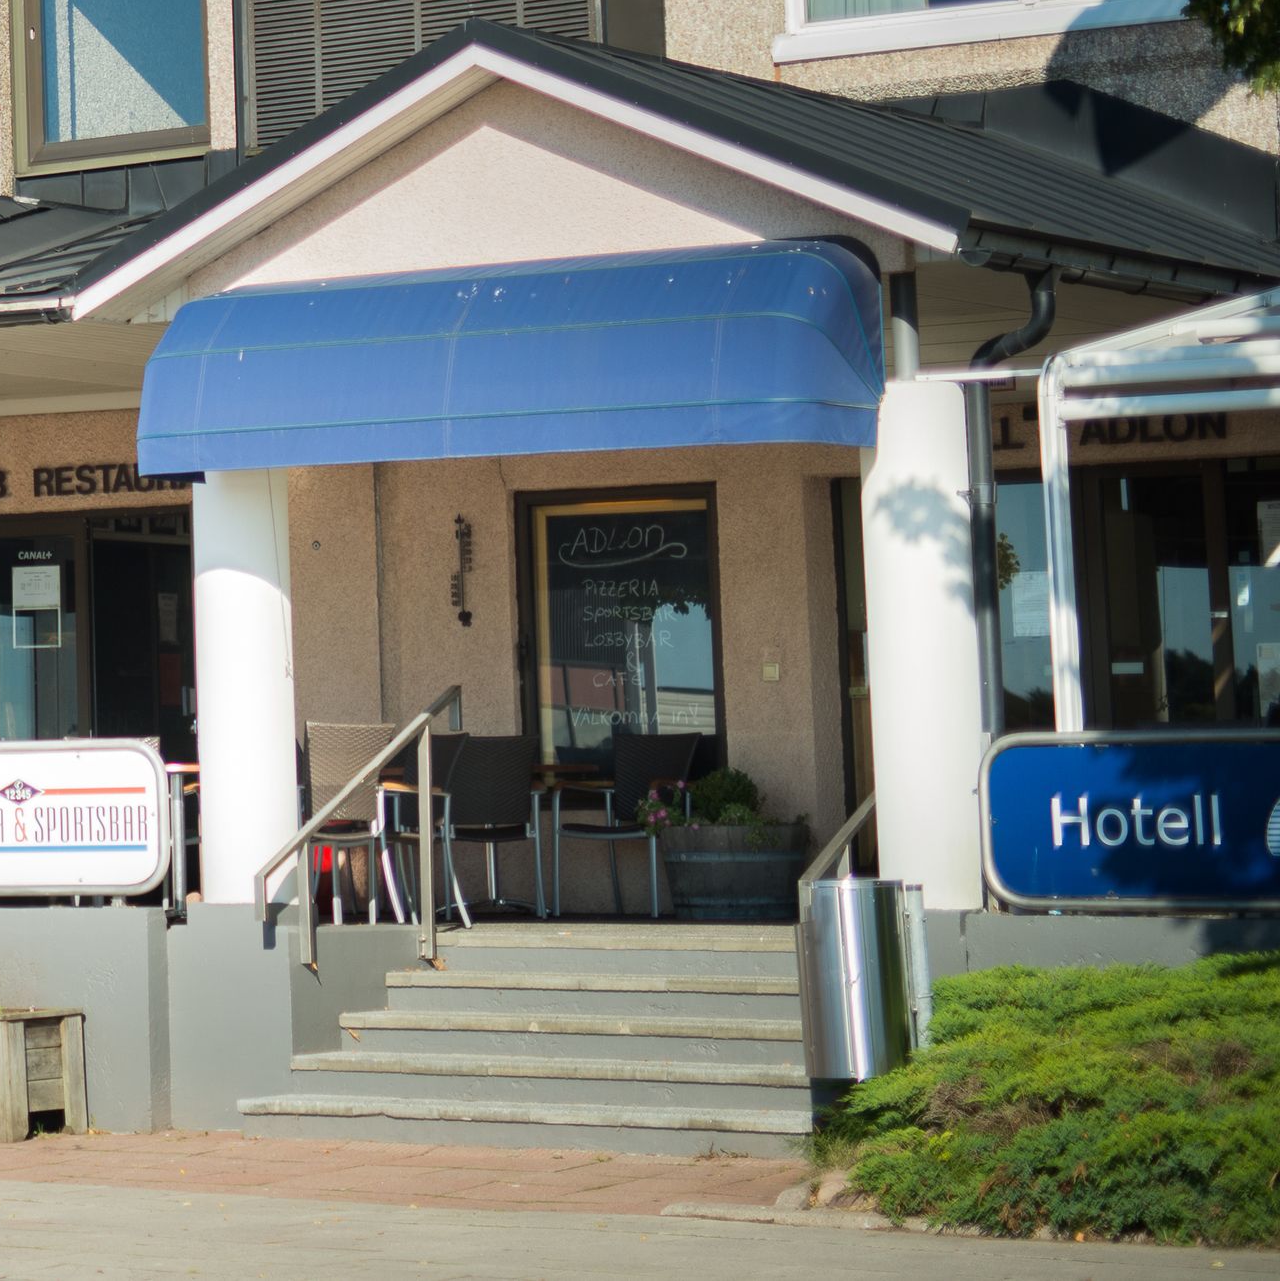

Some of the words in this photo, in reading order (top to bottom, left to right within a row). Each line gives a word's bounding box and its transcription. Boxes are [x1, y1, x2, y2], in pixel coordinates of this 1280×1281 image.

[1079, 412, 1228, 446] ADLON
[18, 550, 53, 560] CANAL+
[5, 788, 33, 801] 12345
[14, 807, 28, 842] &
[34, 805, 148, 843] SPORTSBAR
[1050, 794, 1222, 847] Hotell
